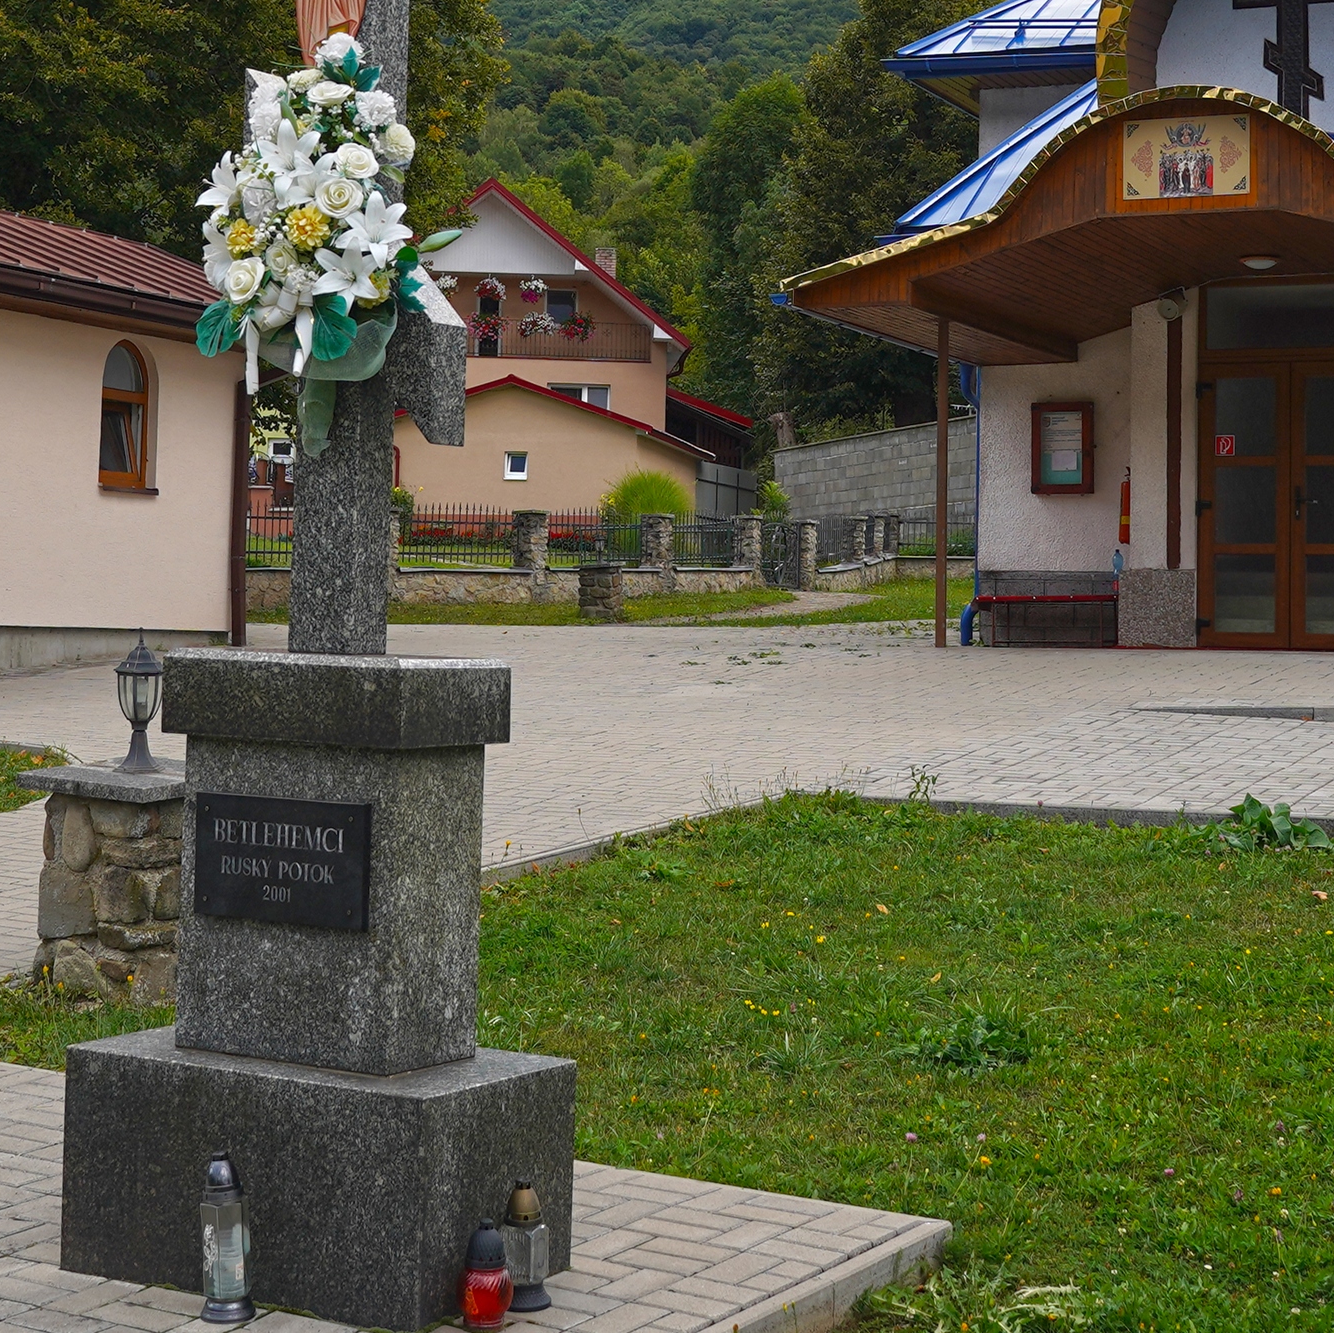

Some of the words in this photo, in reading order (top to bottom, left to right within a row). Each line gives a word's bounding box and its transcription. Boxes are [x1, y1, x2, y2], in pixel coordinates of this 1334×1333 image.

[214, 817, 344, 854] BETLEHEMCI
[278, 860, 335, 884] POTOK
[262, 884, 291, 903] 2001
